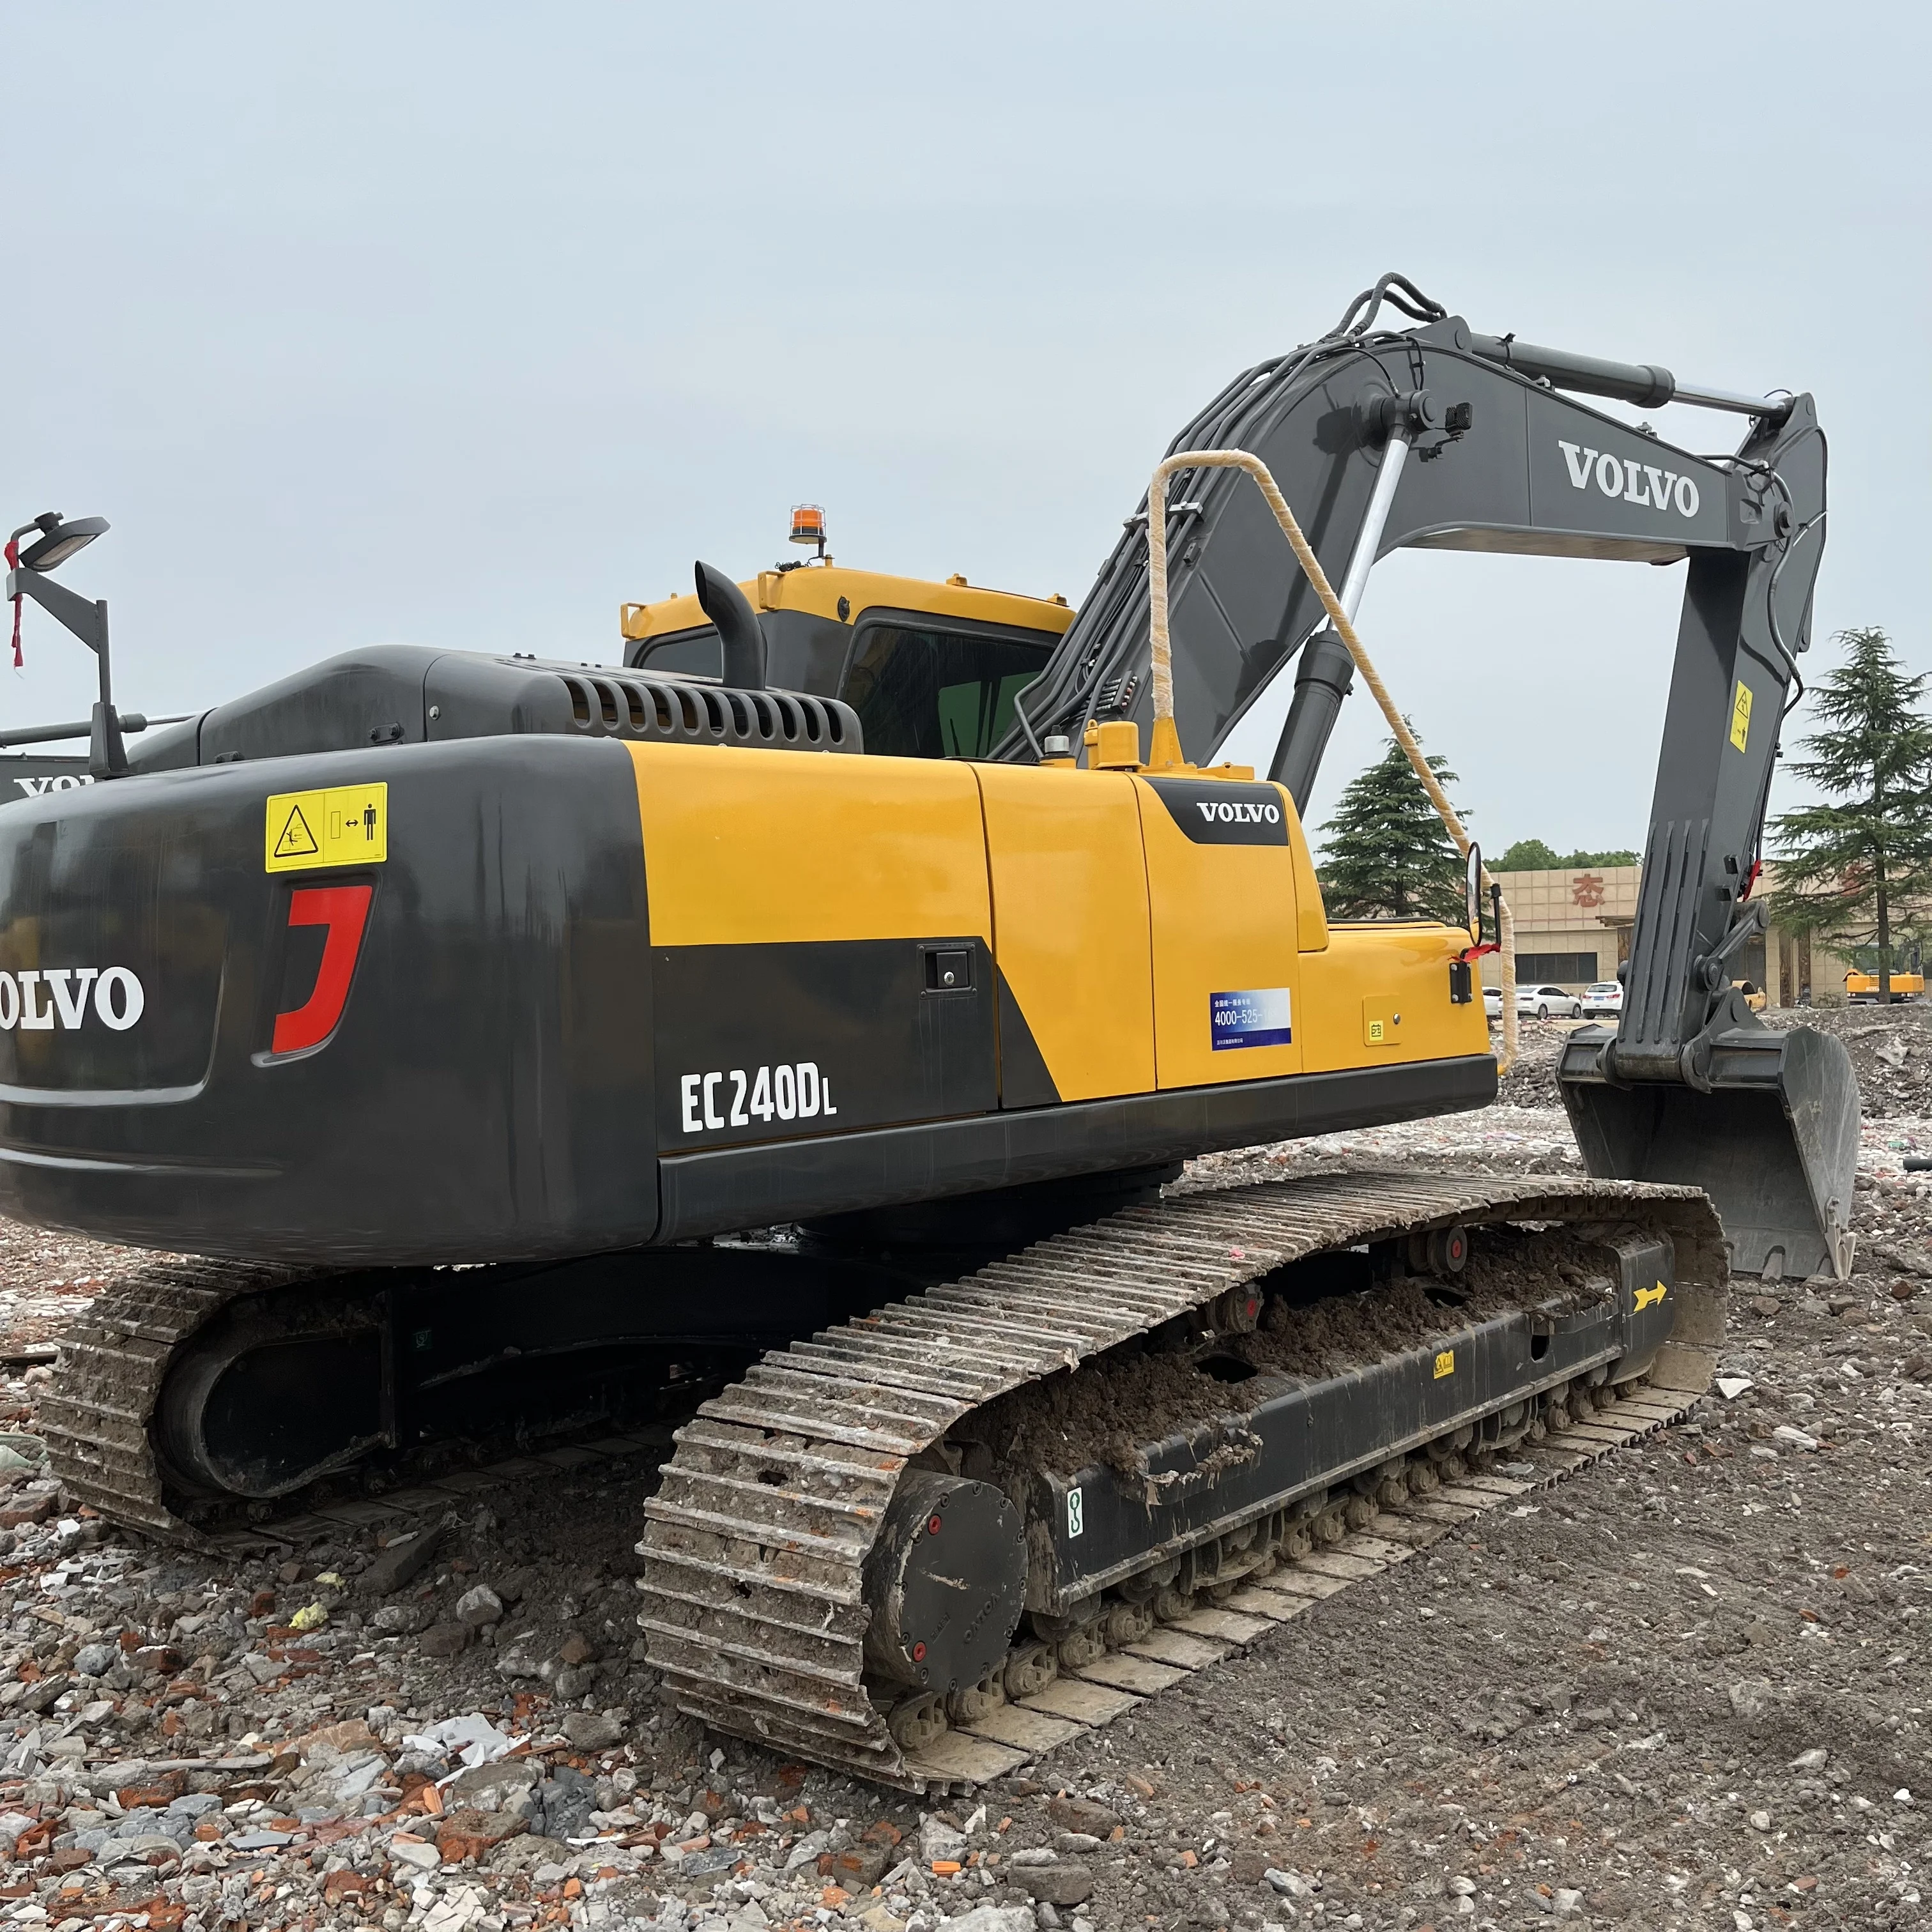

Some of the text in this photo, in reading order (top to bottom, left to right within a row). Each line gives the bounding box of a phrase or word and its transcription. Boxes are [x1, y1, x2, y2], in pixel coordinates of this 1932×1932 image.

[1558, 440, 1699, 518] VOLVO
[1196, 802, 1280, 824] VOLVO
[1572, 873, 1606, 907] 态
